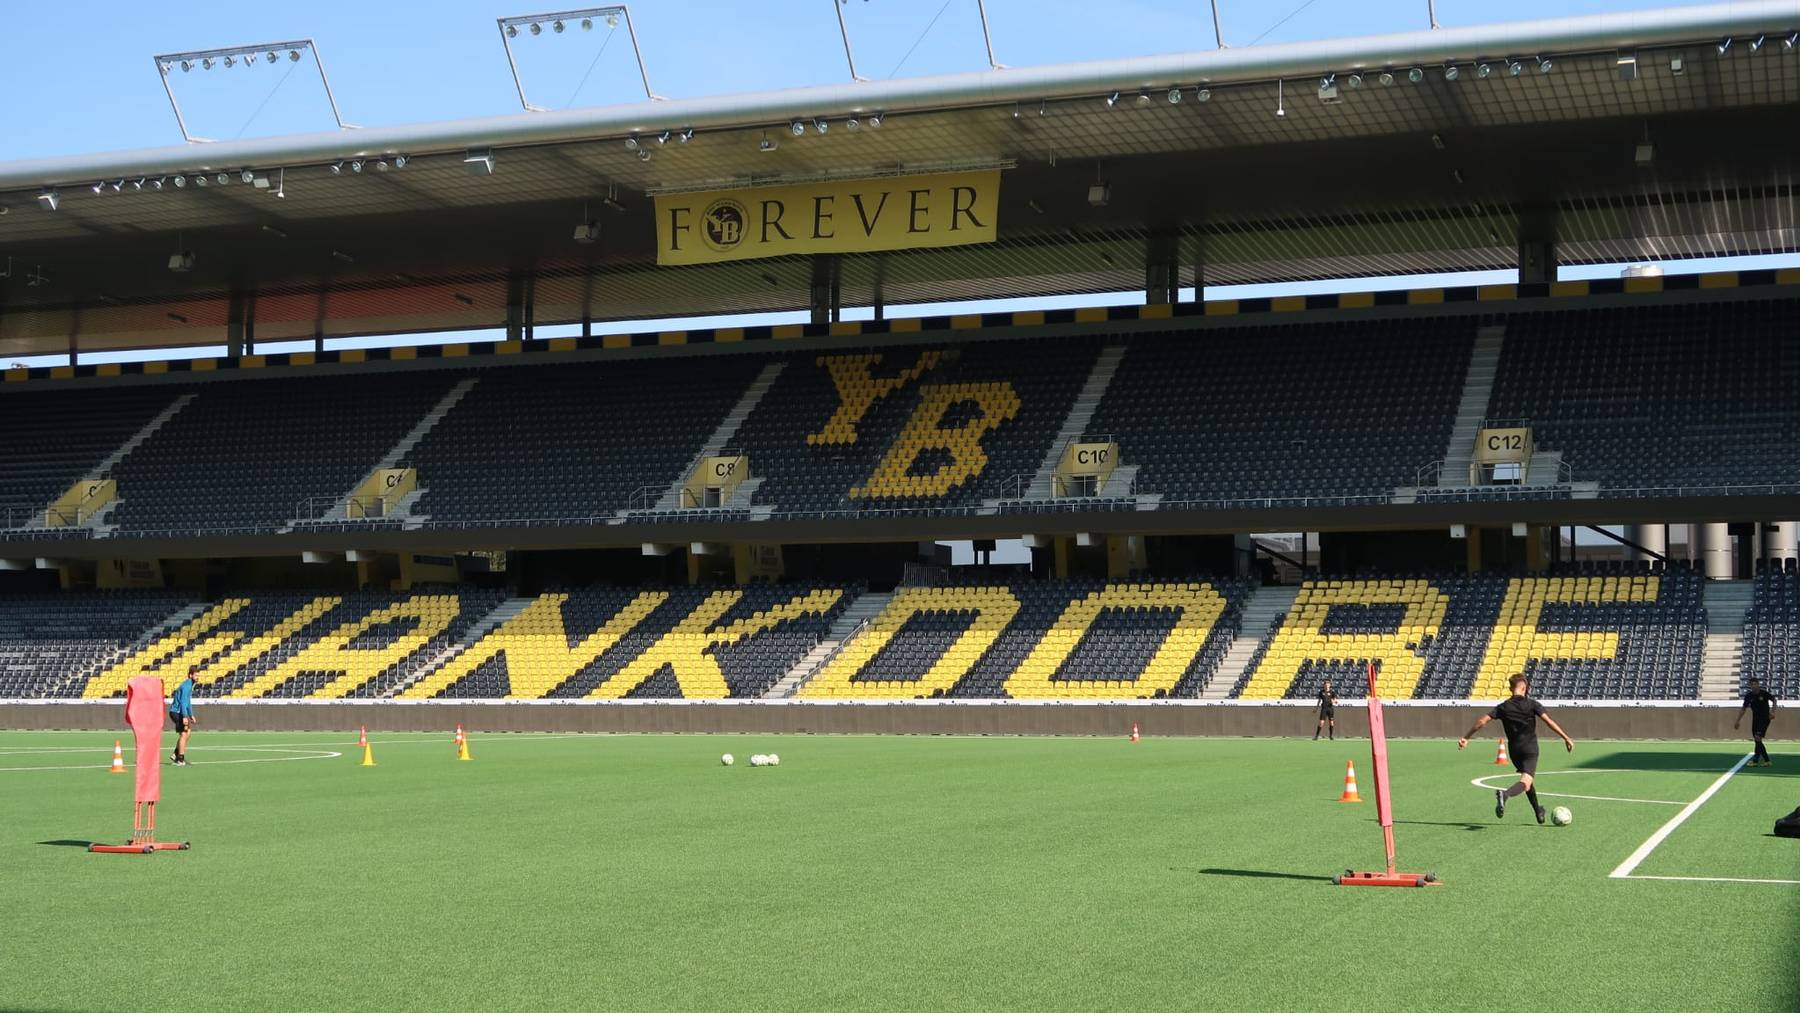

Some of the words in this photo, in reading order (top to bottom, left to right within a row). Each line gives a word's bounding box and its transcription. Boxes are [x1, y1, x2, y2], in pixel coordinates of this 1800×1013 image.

[807, 351, 1022, 498] YB
[1488, 434, 1521, 451] C12
[1078, 449, 1108, 464] C10
[715, 462, 735, 477] C8
